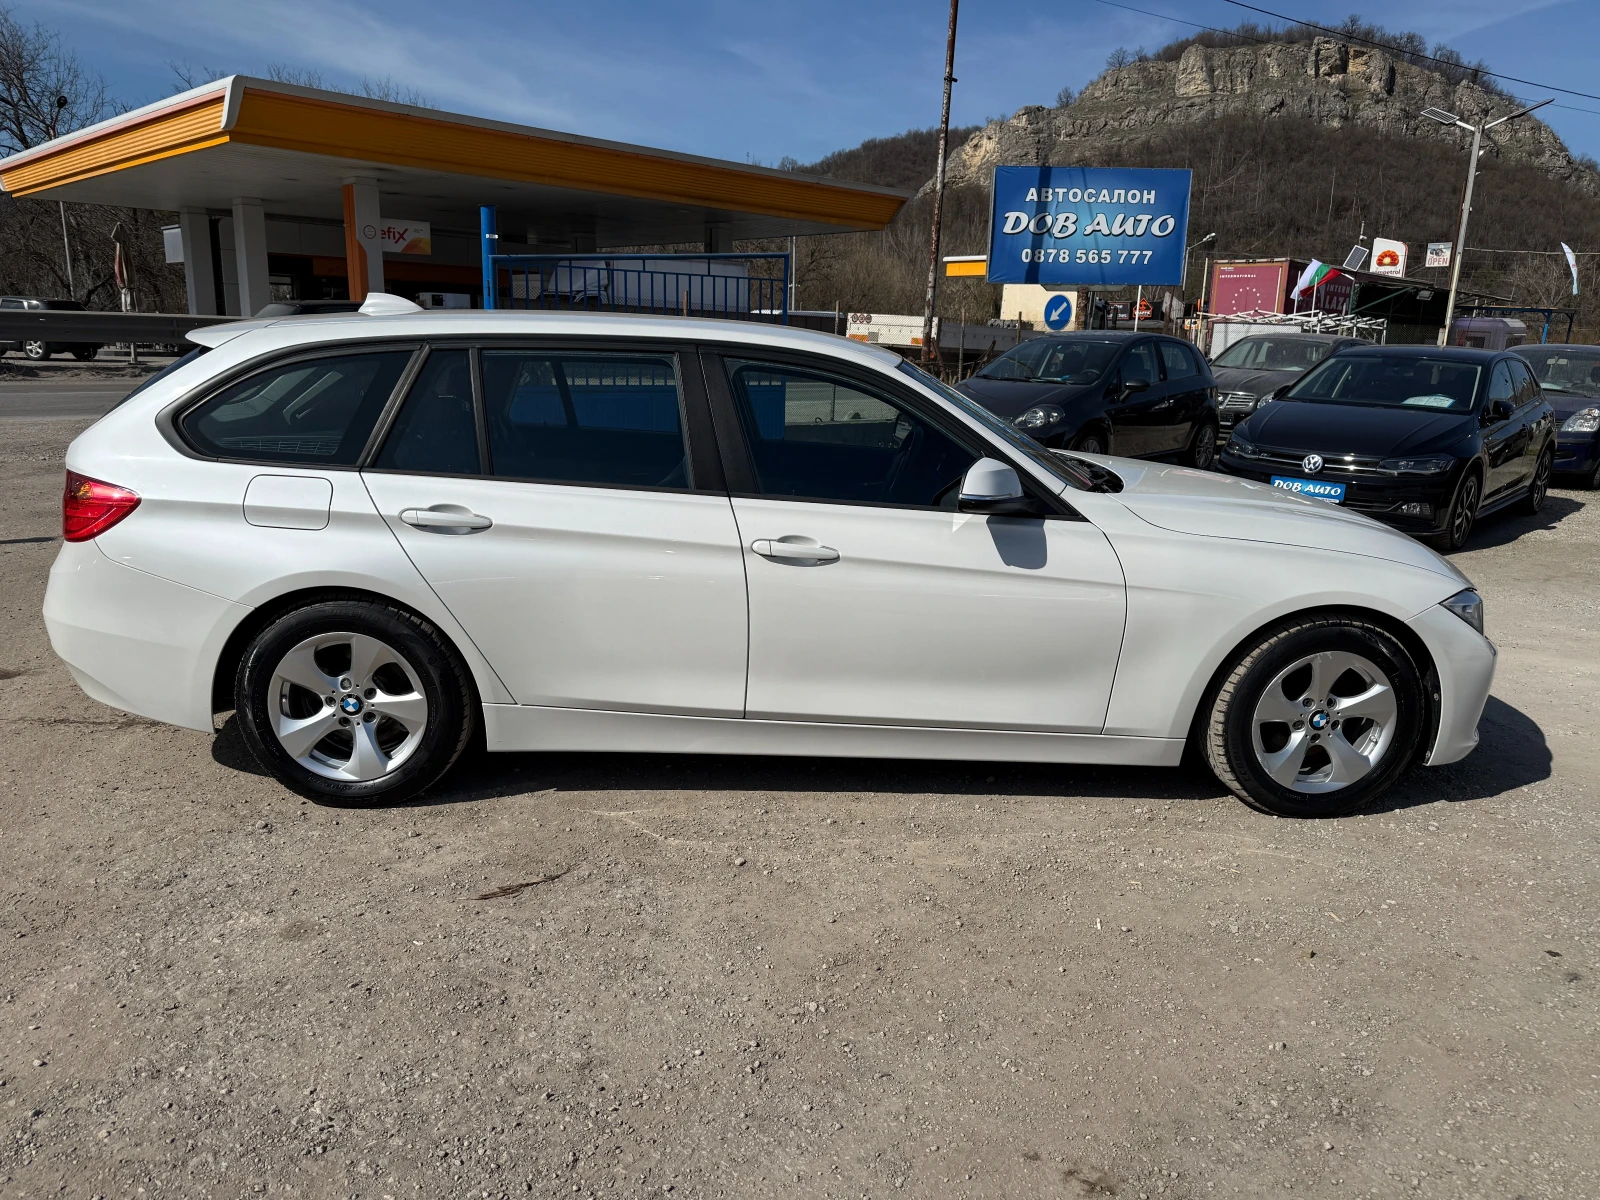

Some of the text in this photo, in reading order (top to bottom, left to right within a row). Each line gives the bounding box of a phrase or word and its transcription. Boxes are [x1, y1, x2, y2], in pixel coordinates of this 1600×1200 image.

[1025, 187, 1156, 204] АВТОСАЛОН
[1002, 211, 1176, 239] DOB AUTO
[1021, 248, 1153, 265] 0878 565 777
[1428, 257, 1448, 266] OPEN
[1273, 480, 1341, 496] DOB AUTO
